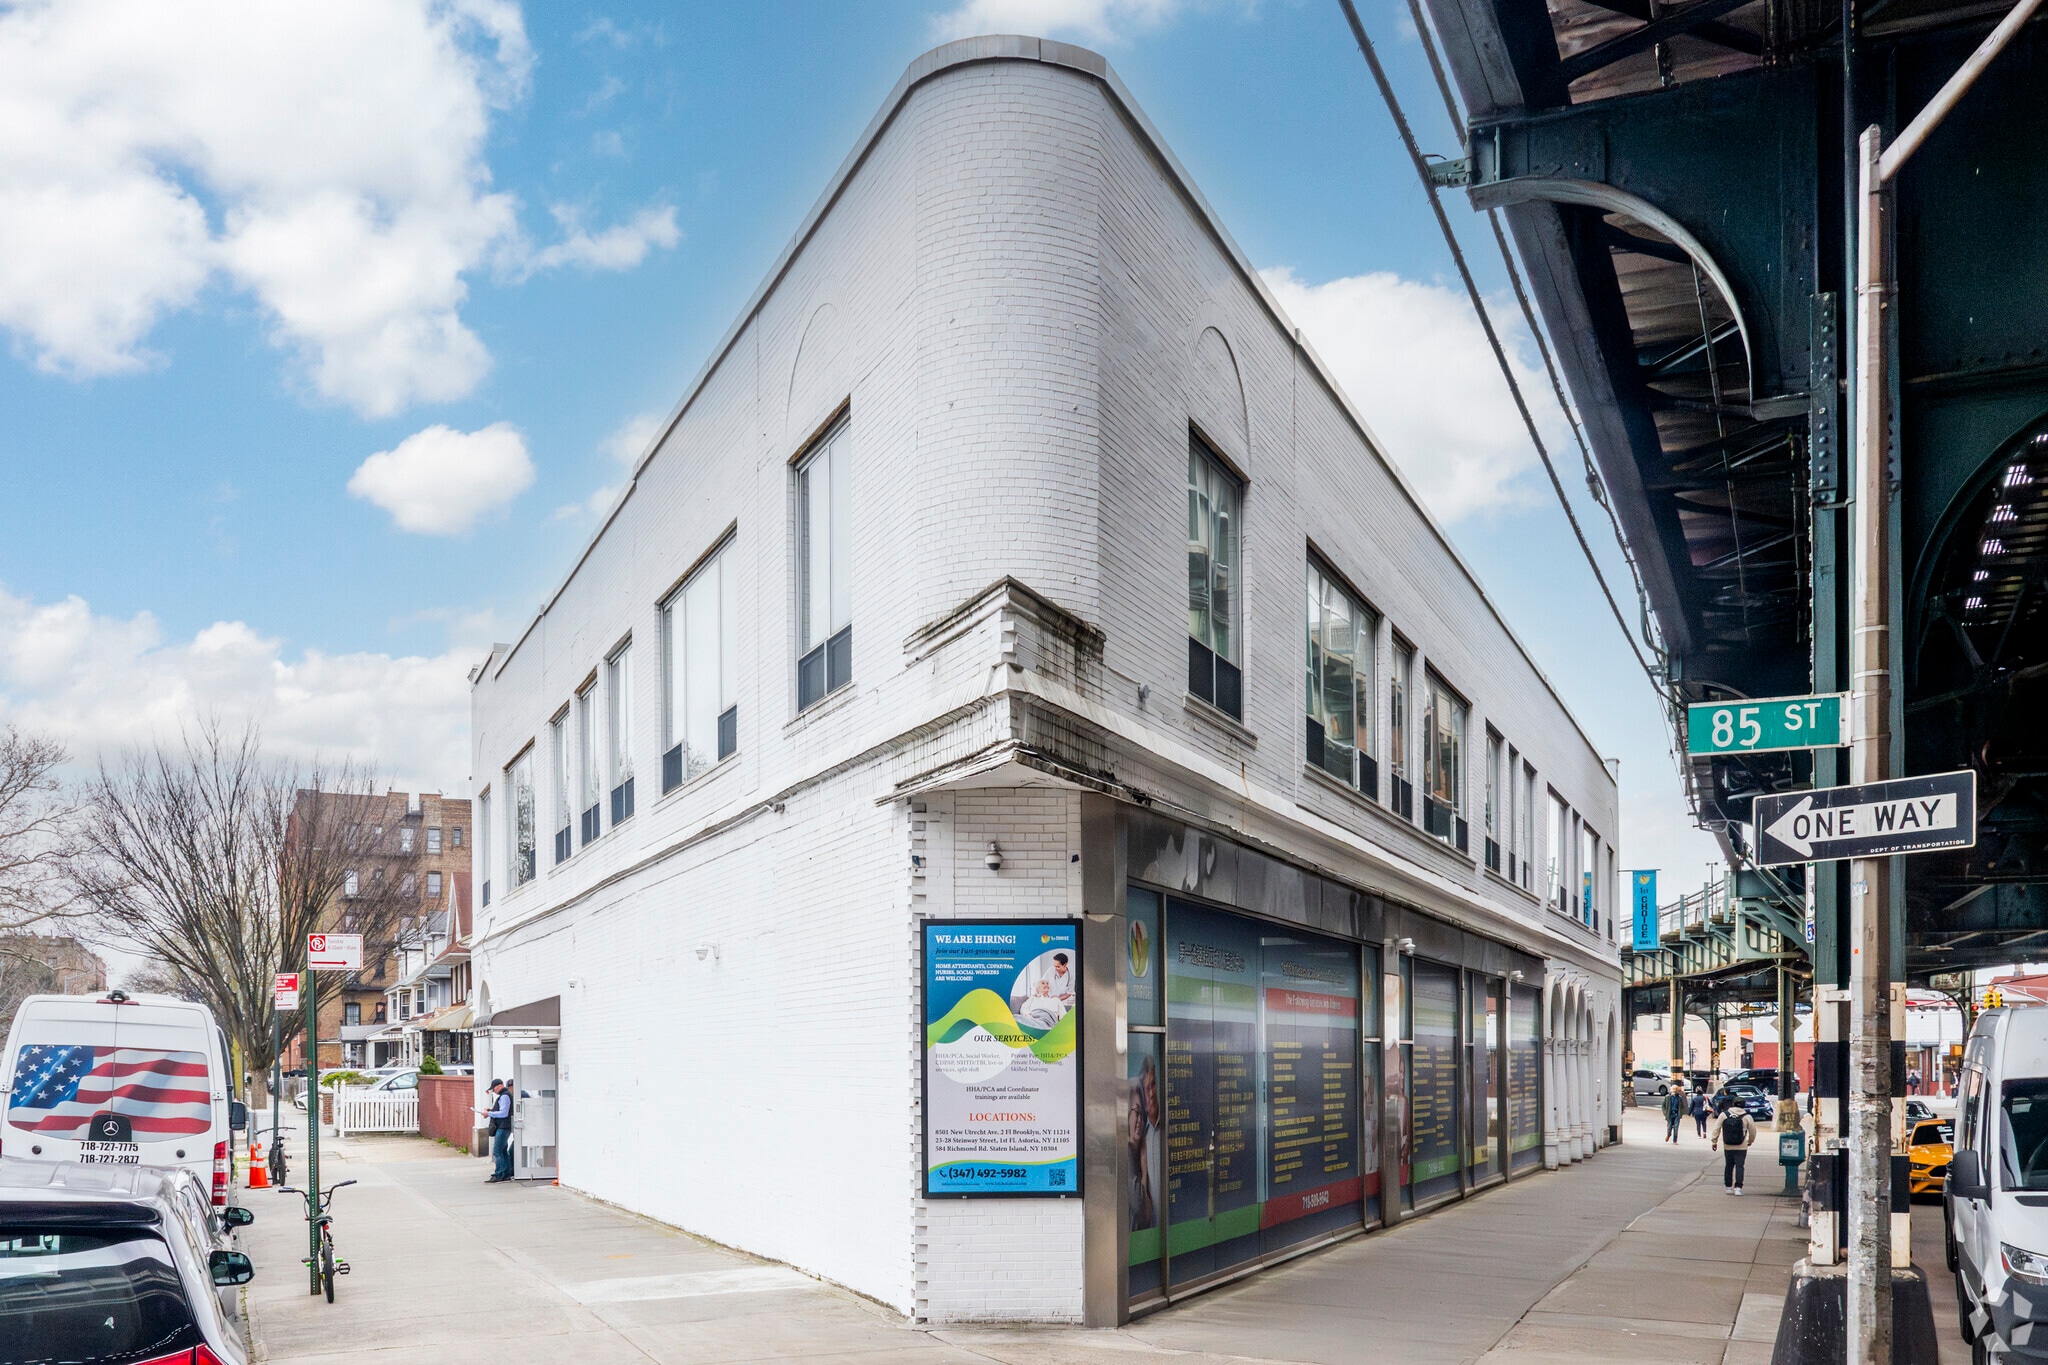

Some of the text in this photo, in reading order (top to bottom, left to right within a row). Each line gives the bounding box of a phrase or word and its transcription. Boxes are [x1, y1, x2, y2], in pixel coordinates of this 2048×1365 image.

[1711, 702, 1822, 748] 85 ST
[1793, 798, 1942, 841] ONE WAY
[1902, 840, 1966, 850] TRANSPORTATION
[935, 934, 1016, 944] WE ARE HIRING!
[969, 1112, 1036, 1122] LOCATIONS:
[80, 1142, 138, 1152] 718-727-7775
[80, 1154, 140, 1164] 718-727-2877
[949, 1168, 1026, 1180] (347) 492-5982
